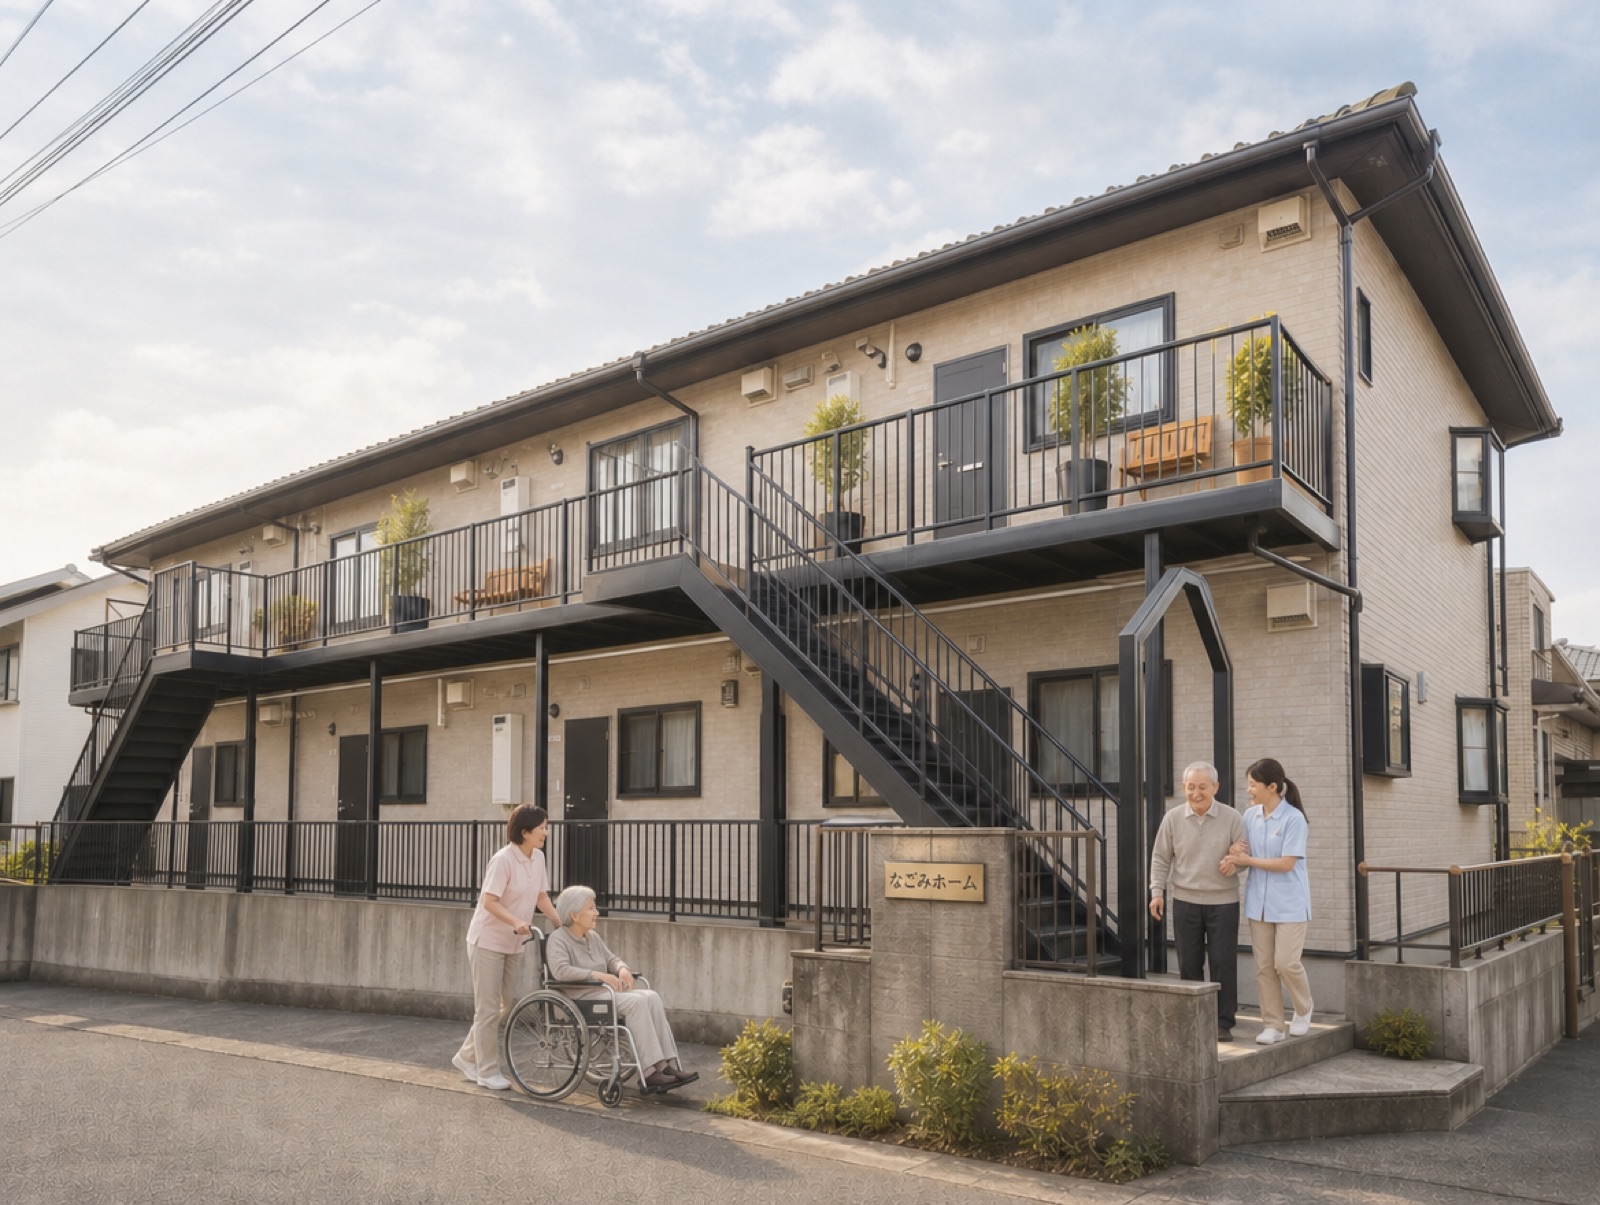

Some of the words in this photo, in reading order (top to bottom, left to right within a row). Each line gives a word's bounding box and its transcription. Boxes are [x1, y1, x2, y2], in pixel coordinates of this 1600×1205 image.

[889, 872, 977, 890] なごみホーム
